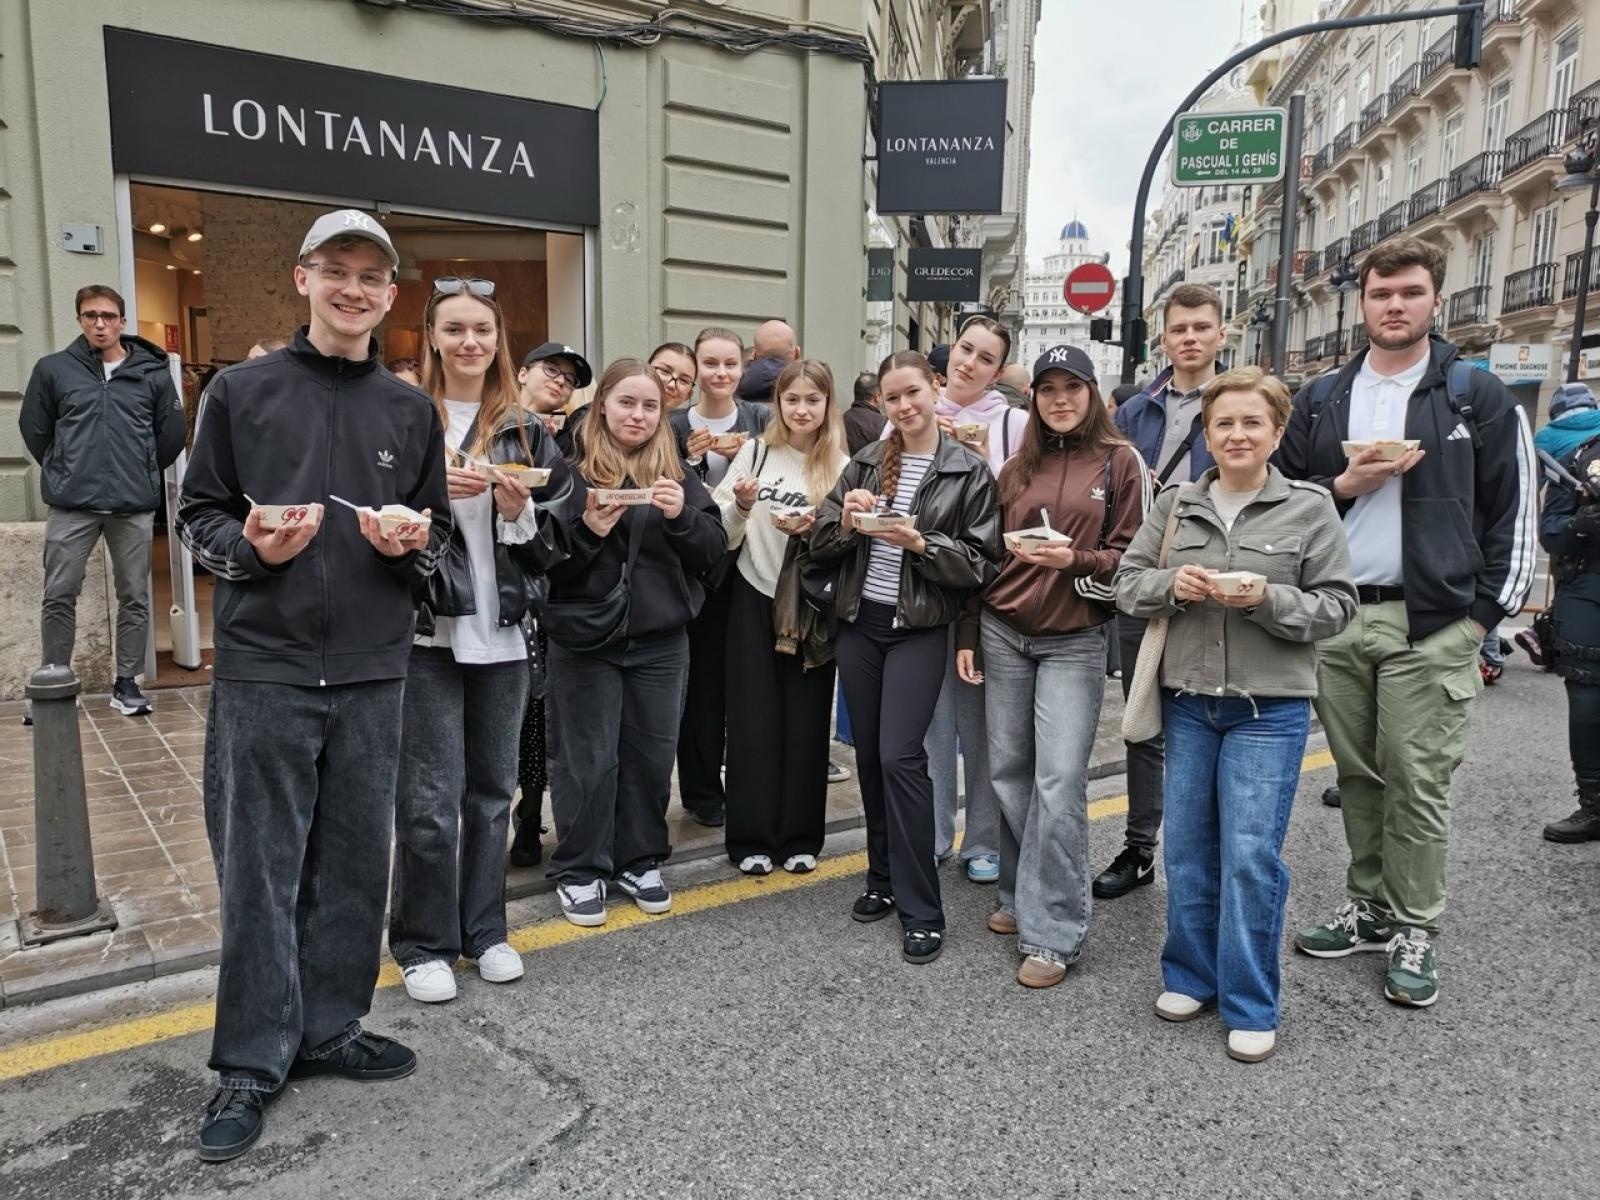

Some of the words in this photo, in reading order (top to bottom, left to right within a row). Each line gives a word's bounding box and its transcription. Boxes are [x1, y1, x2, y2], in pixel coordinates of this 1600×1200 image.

[1207, 118, 1275, 135] CARRER
[203, 93, 535, 178] LONTANANZA
[886, 136, 995, 152] LONTANANZA
[1219, 138, 1239, 150] DE
[1181, 154, 1232, 170] PASCUAL
[1235, 154, 1239, 167] I
[1242, 148, 1278, 167] GENÍS
[914, 266, 974, 276] GREDECOR
[281, 507, 309, 526] 99
